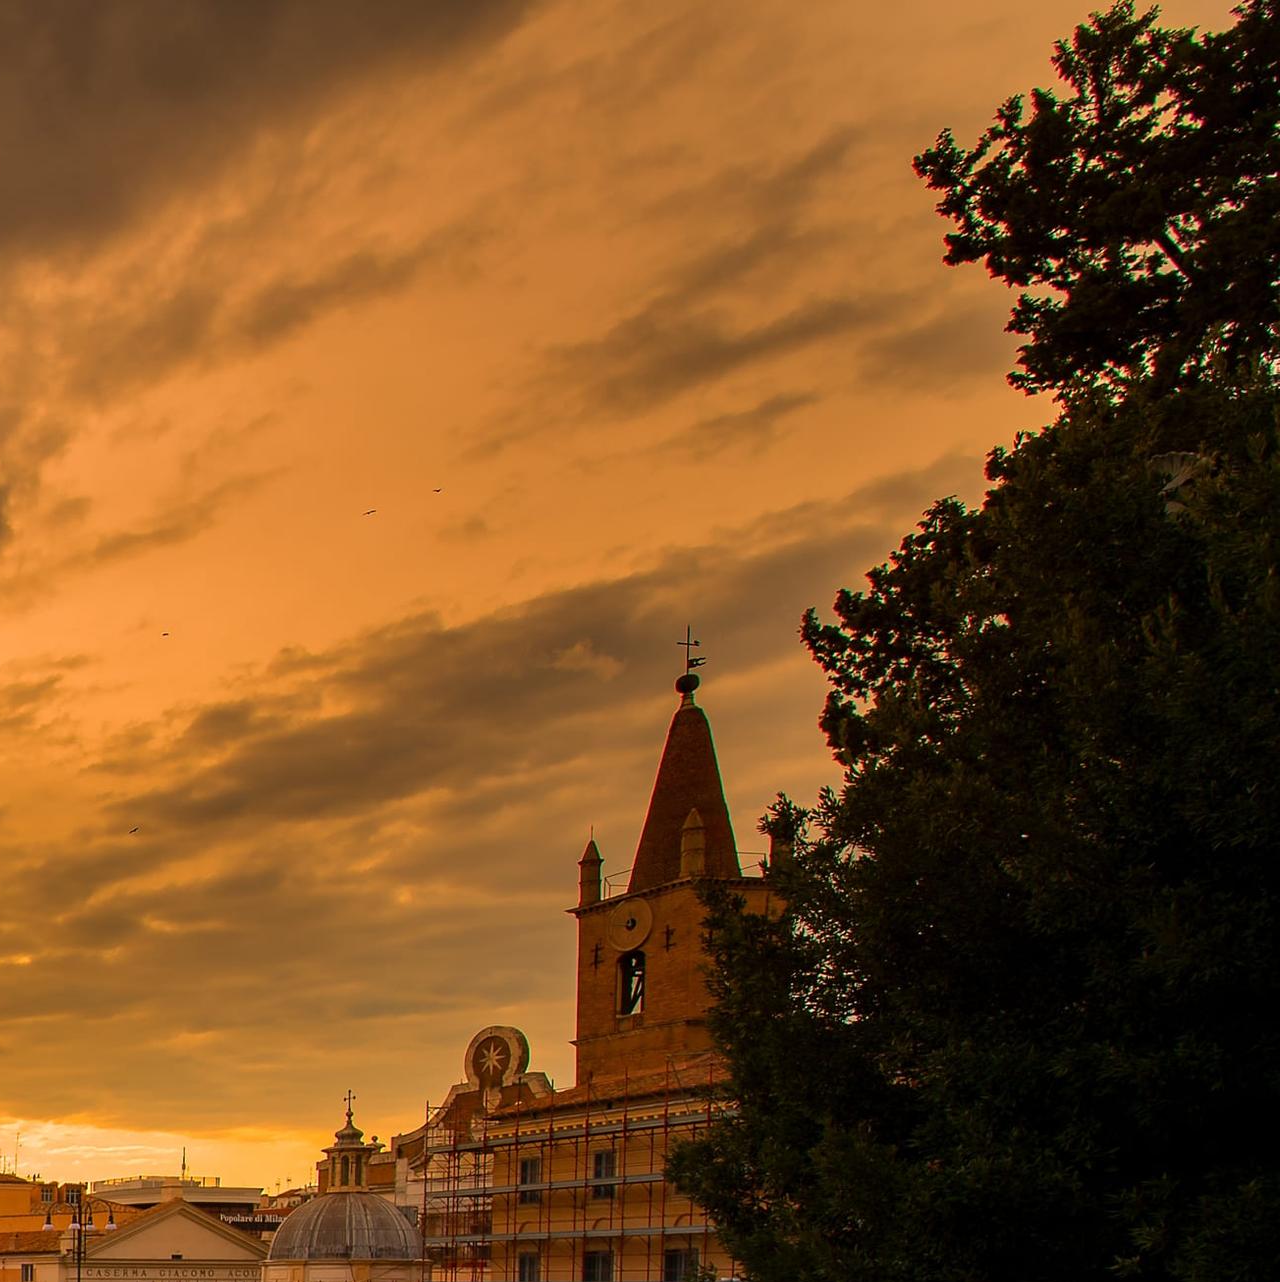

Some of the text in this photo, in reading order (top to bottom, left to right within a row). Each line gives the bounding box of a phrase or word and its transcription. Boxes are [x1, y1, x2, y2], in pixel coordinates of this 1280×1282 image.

[220, 1213, 253, 1225] Popolare
[255, 1213, 263, 1222] di
[87, 1269, 261, 1277] CASERMA GIACOMO ACQU
